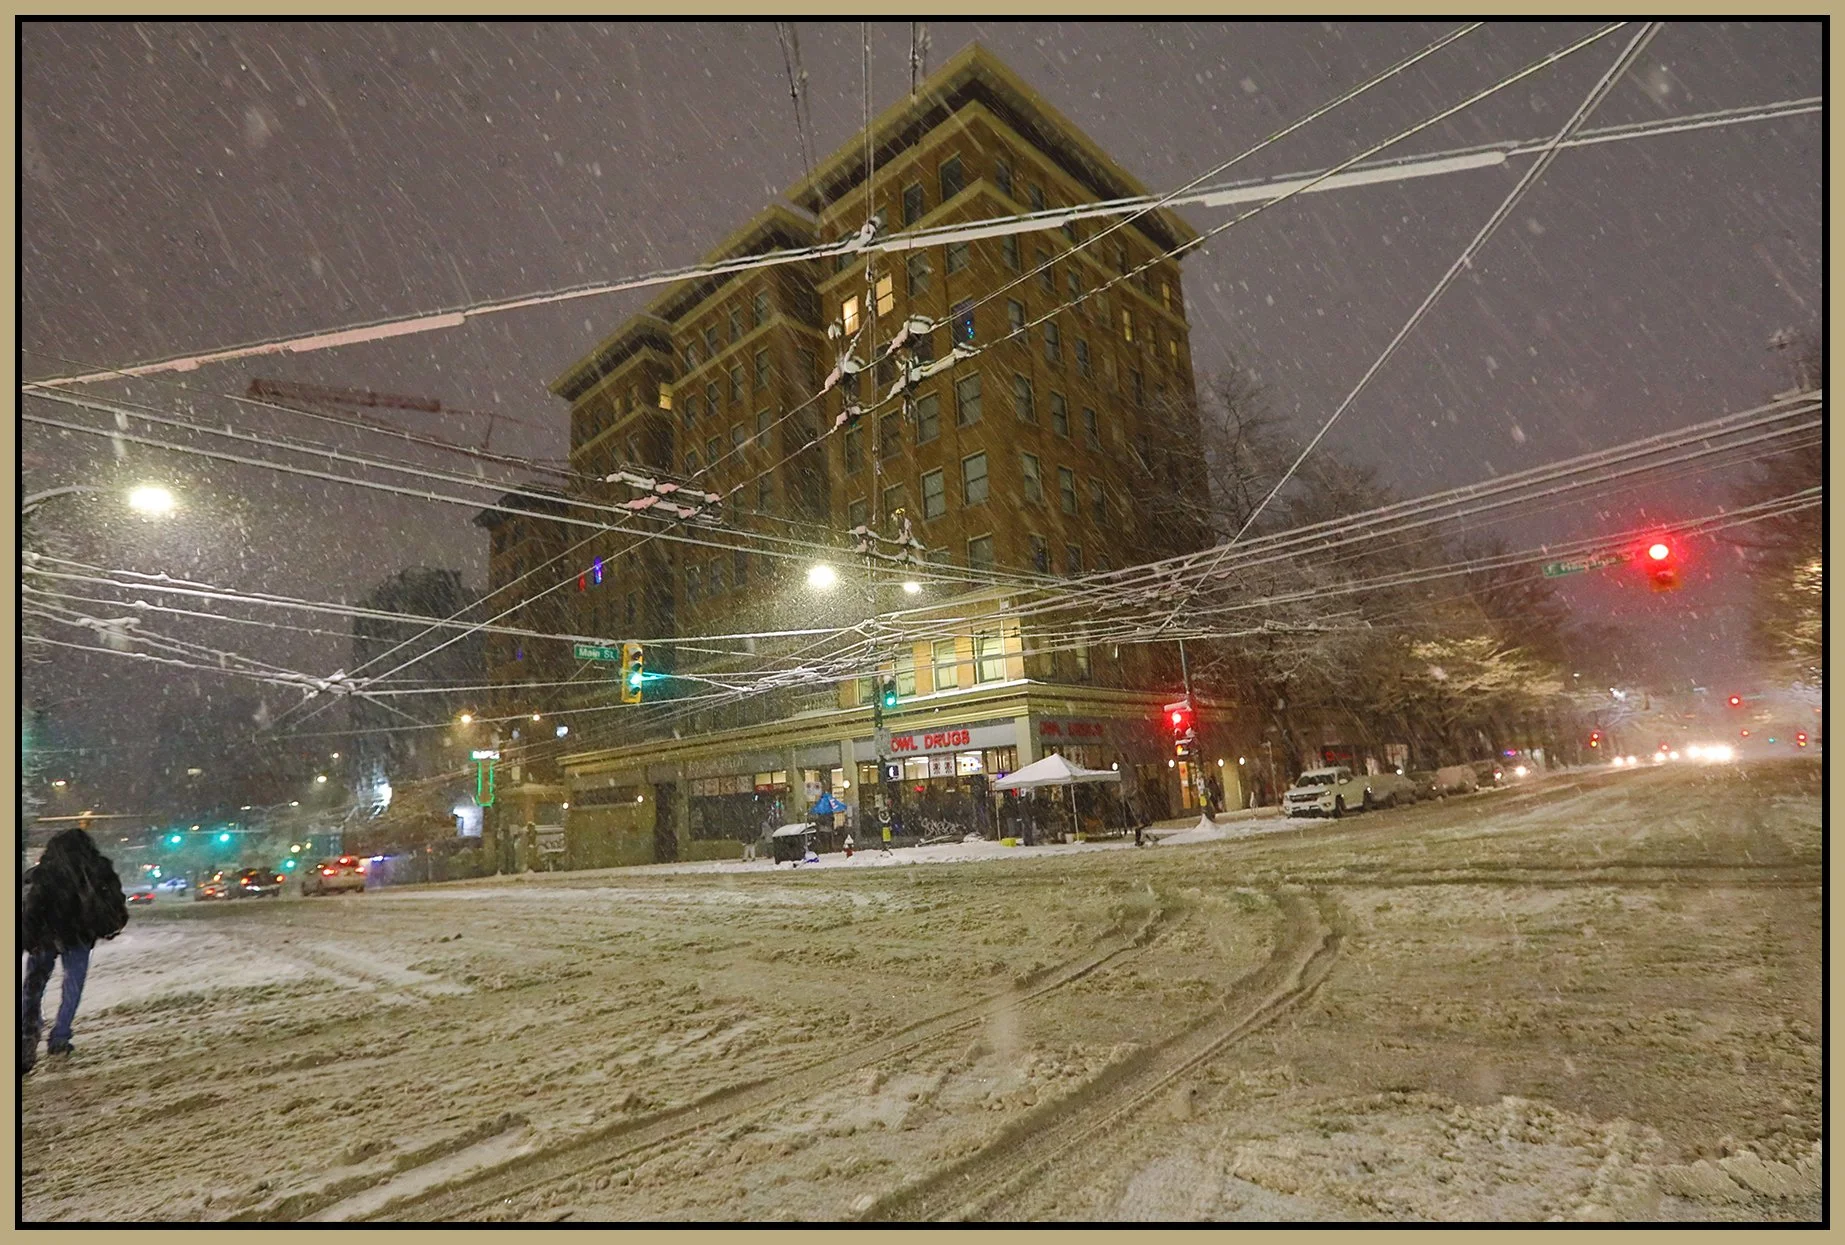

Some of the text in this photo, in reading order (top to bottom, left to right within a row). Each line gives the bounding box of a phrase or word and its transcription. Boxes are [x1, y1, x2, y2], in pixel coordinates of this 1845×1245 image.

[578, 647, 601, 658] Main
[890, 729, 970, 752] OWL DRUGS
